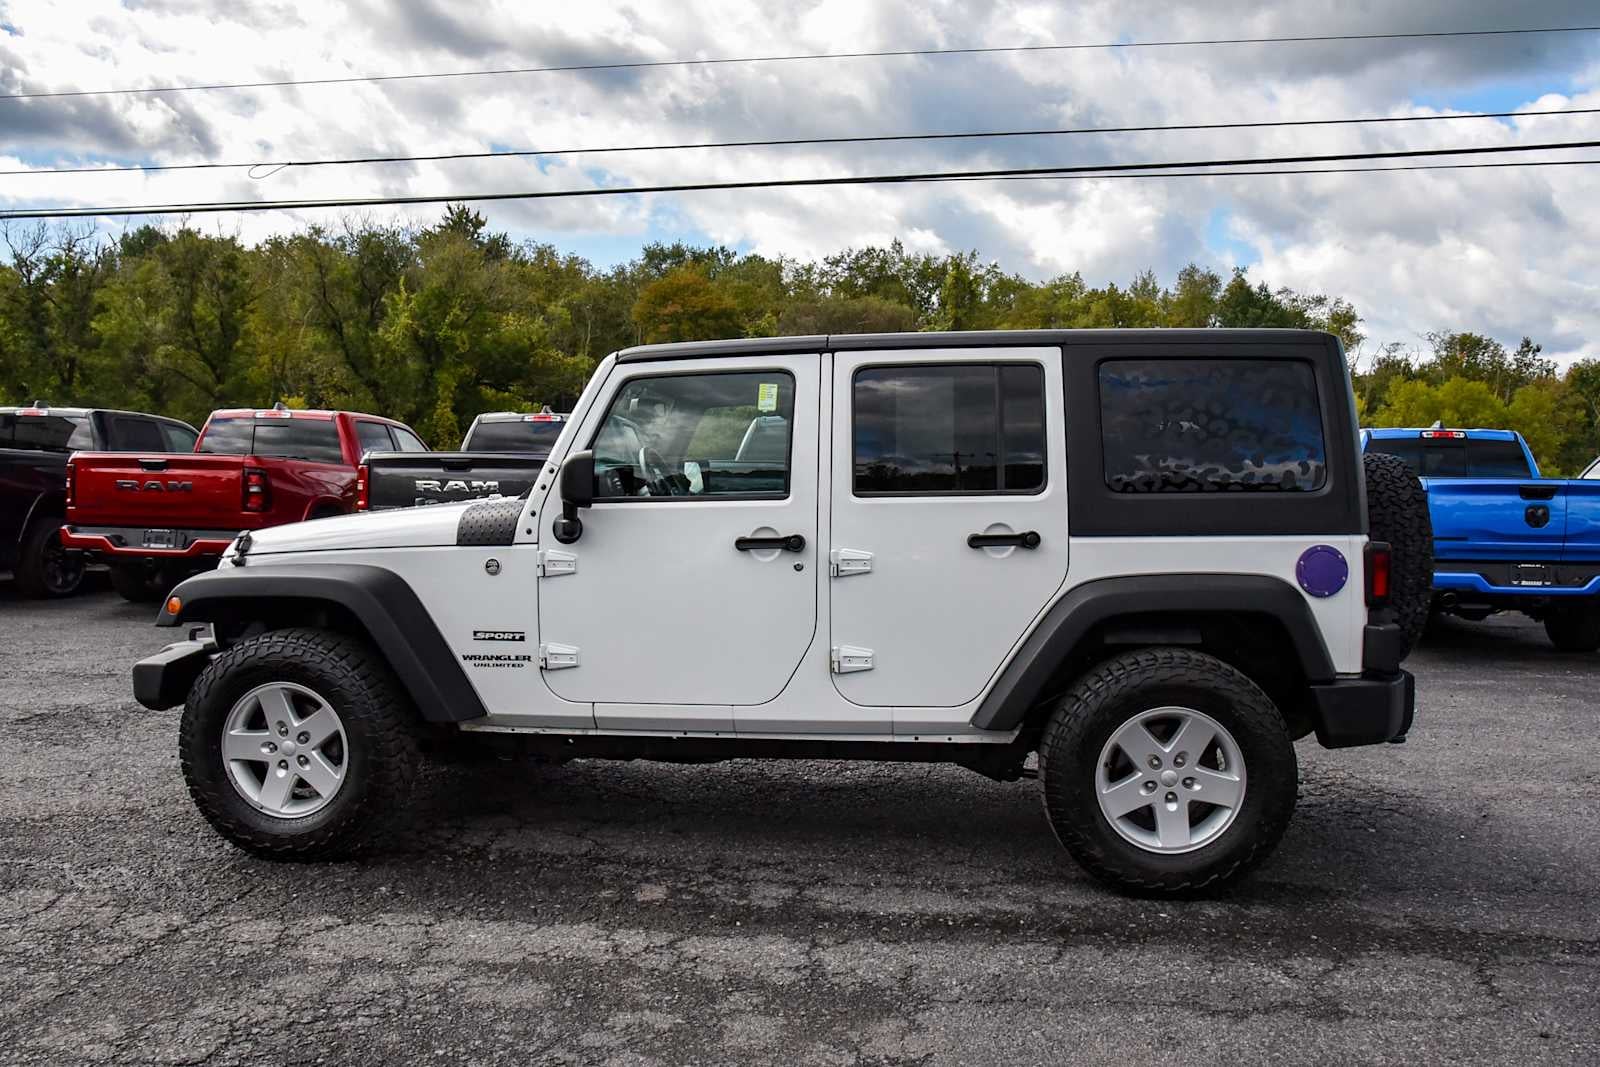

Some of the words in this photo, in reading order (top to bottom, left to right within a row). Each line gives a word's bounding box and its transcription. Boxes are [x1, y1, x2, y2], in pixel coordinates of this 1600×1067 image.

[115, 479, 193, 491] RAM
[415, 480, 499, 492] RAM
[473, 631, 525, 640] SPORT
[461, 654, 532, 662] WRANGLER
